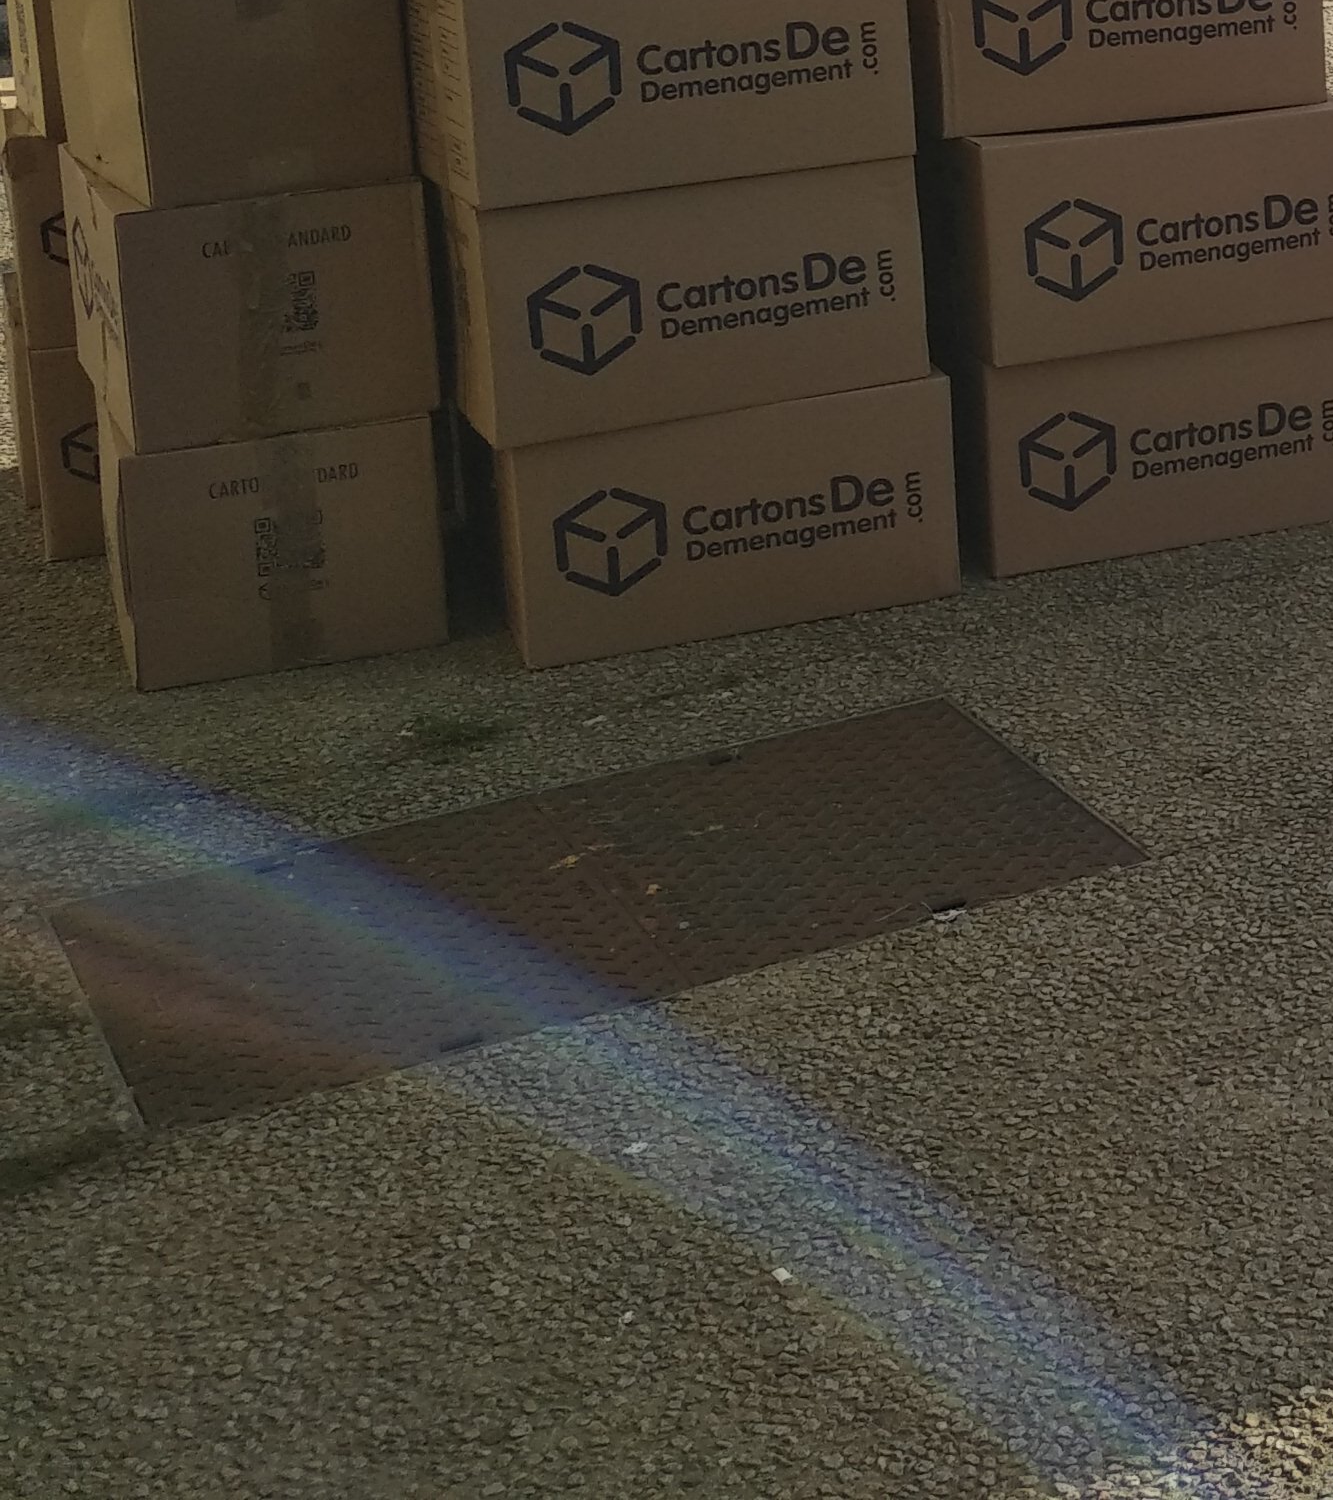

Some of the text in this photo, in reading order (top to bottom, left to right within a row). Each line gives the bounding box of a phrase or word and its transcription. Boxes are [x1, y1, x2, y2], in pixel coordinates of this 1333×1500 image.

[859, 20, 881, 76] .com
[1087, 14, 1277, 49] Demenagement
[639, 57, 855, 104] Demenagement
[1138, 227, 1323, 272] Demenagement
[876, 248, 897, 303] .com
[659, 287, 872, 340] Demenagement
[1131, 434, 1316, 481] Demenagement
[208, 476, 259, 500] CARTO
[903, 470, 925, 525] .com
[685, 508, 899, 562] Demenagement
